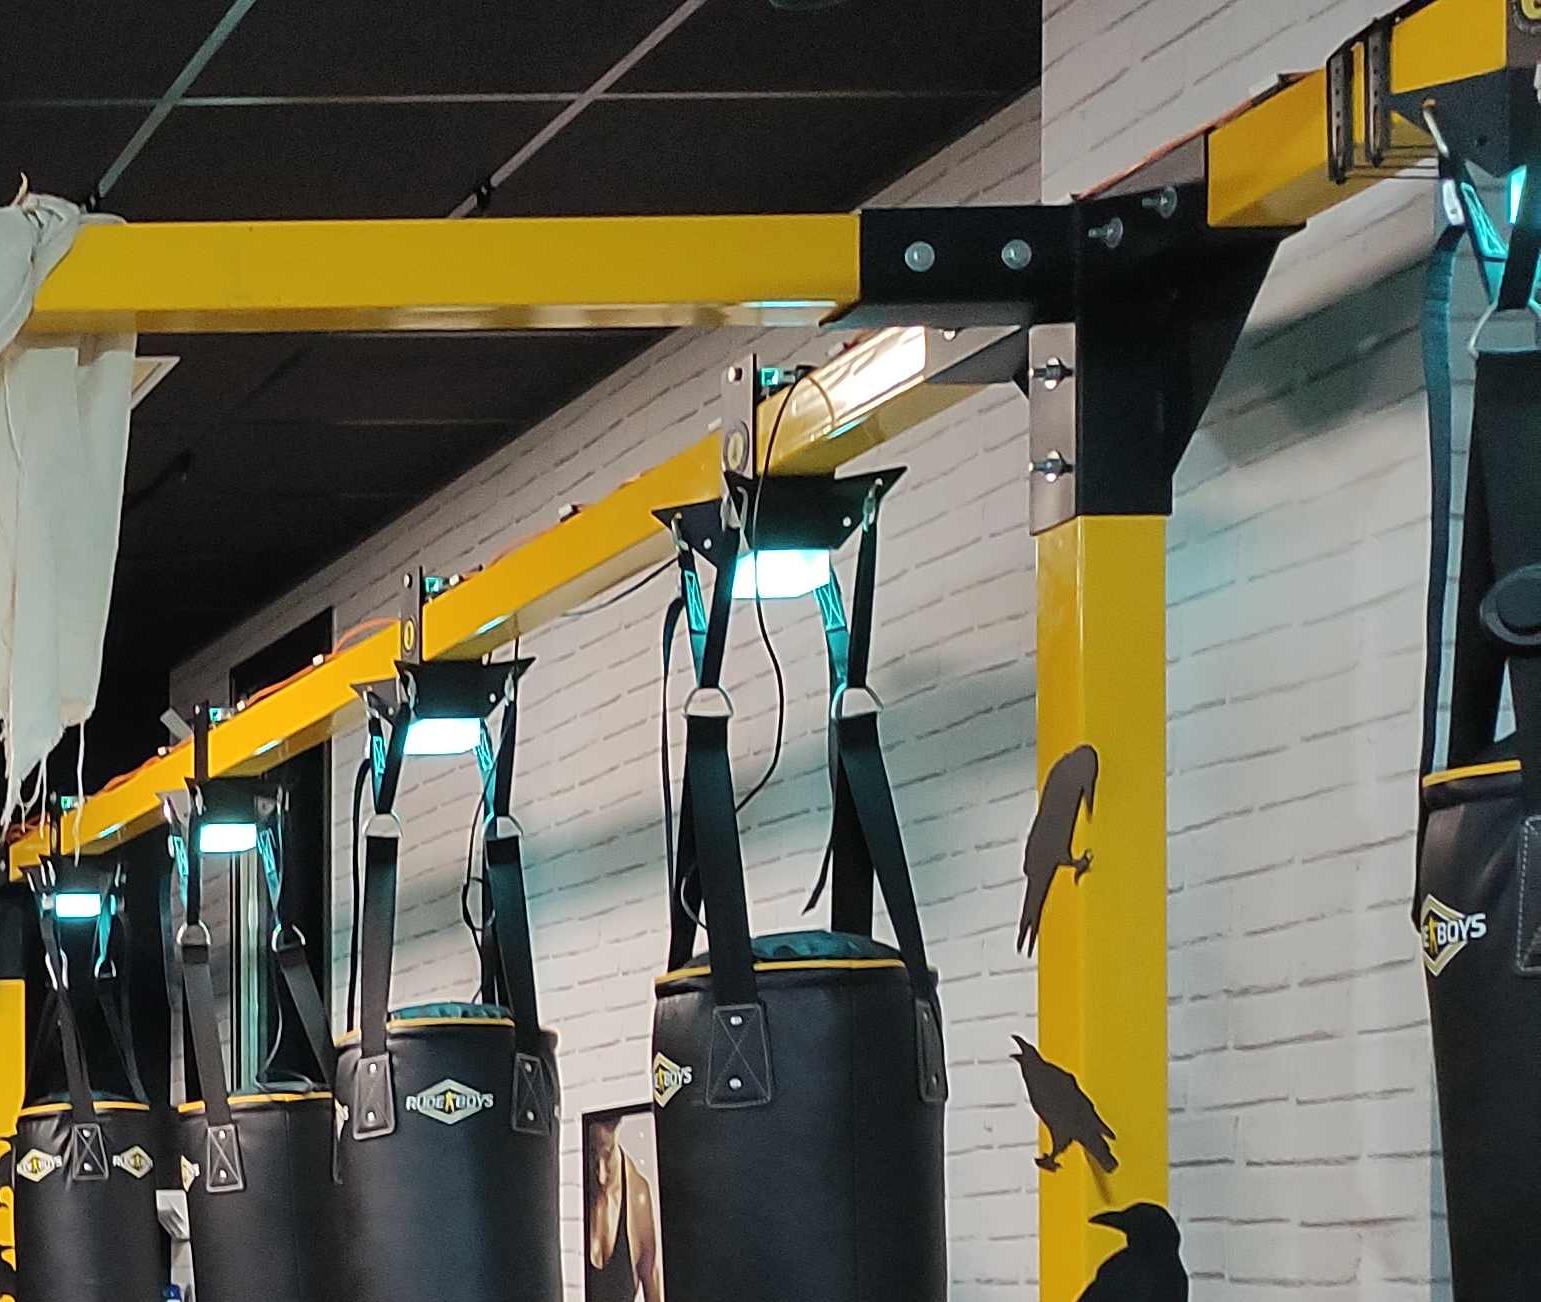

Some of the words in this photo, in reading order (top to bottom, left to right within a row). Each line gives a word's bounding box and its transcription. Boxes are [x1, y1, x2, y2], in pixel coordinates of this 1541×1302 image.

[1436, 913, 1487, 945] BOYS
[664, 1066, 693, 1087] BOYS
[405, 1095, 445, 1111] RUDE
[455, 1093, 494, 1109] BOYS
